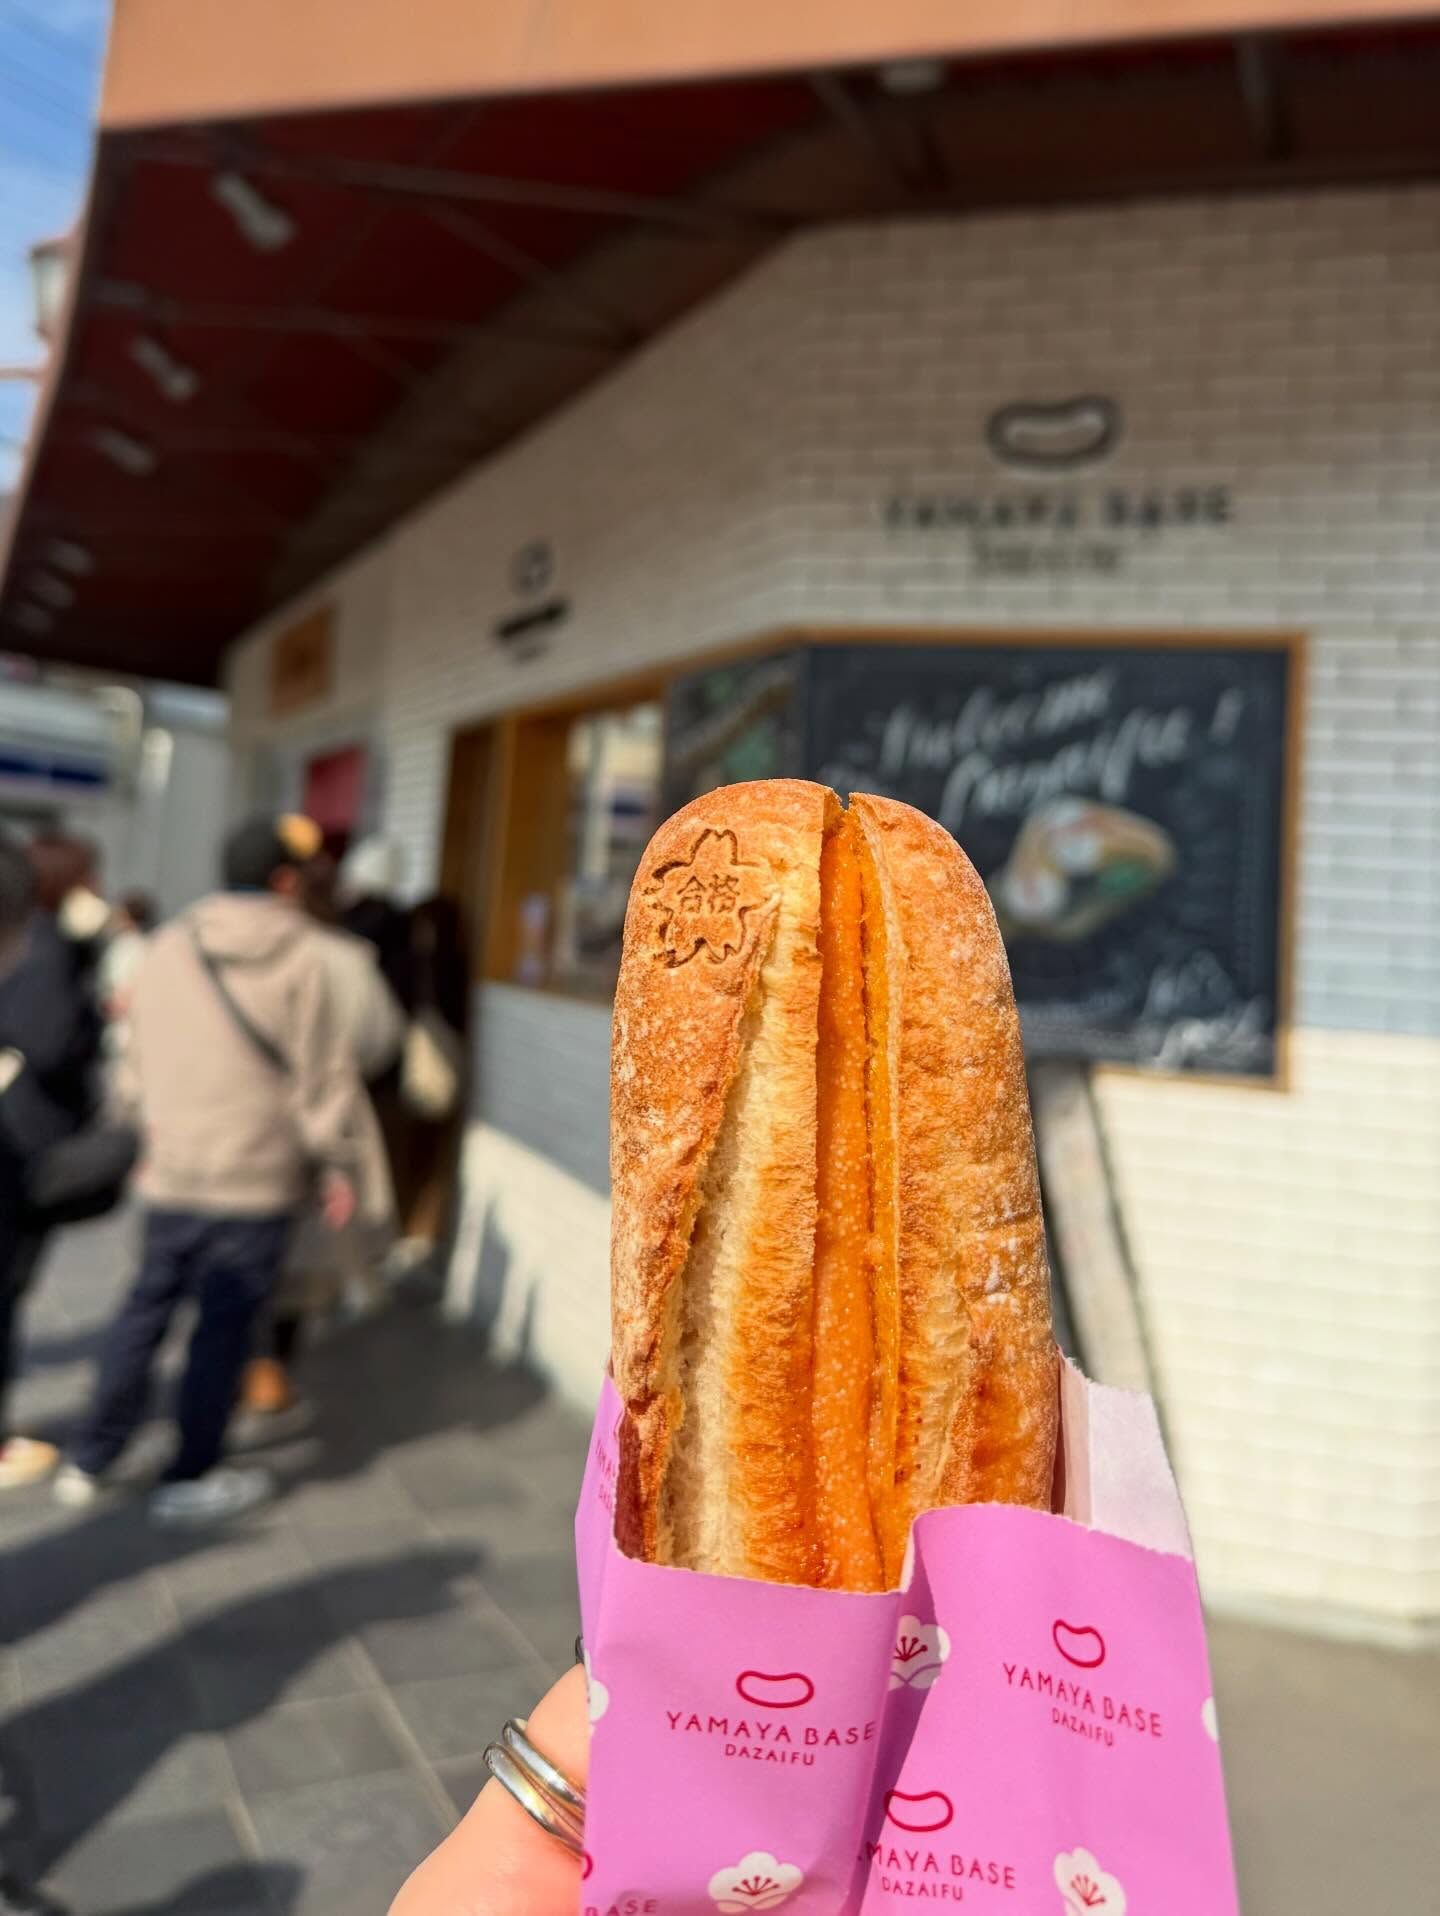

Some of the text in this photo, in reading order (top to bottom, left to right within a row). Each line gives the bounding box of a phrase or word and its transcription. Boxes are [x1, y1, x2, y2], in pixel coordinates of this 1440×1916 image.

[676, 873, 740, 914] 合格
[1003, 1662, 1162, 1737] YAMAYA BASE
[666, 1711, 876, 1746] YAMAYA BASE
[1052, 1707, 1114, 1746] DAZAIFU
[724, 1743, 815, 1766] DAZAIFU
[857, 1841, 1015, 1889] MAYA BASE
[882, 1876, 963, 1901] DAZAIFU
